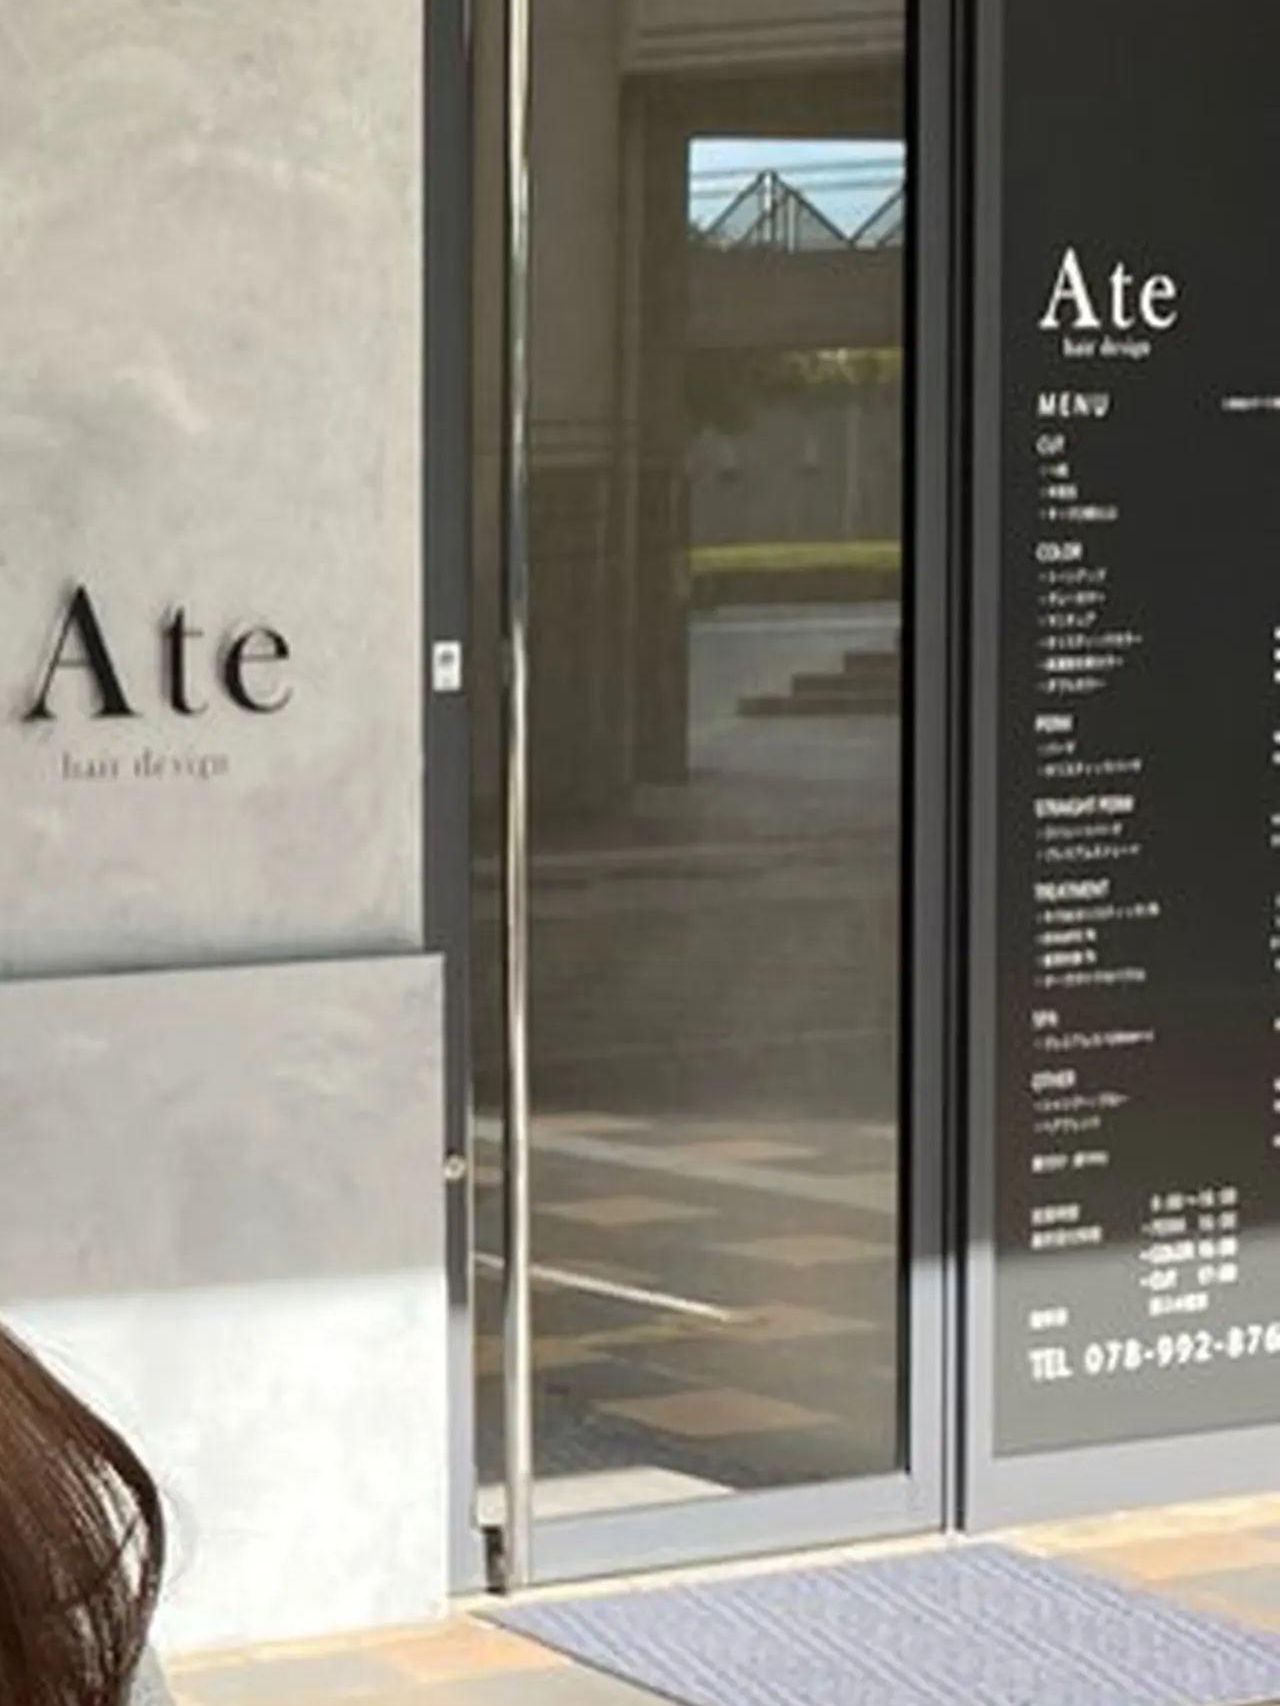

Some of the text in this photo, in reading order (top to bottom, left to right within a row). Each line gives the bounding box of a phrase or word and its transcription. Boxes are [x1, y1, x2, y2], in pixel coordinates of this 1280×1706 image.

[1038, 246, 1178, 329] Ate
[1037, 392, 1110, 417] MENU
[17, 582, 294, 724] Ate
[1028, 1346, 1074, 1381] TEL
